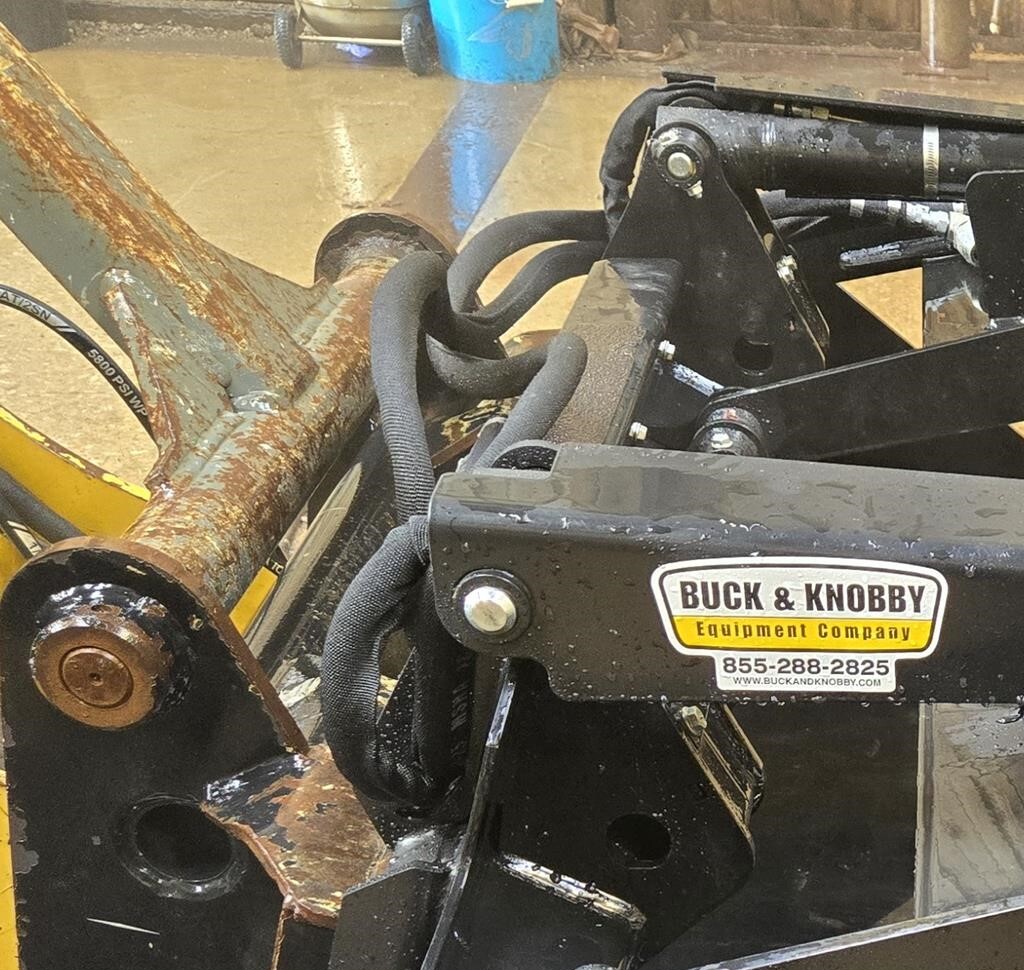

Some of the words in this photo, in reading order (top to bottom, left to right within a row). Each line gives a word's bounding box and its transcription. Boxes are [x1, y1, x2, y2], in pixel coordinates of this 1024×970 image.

[87, 348, 116, 377] 5800
[112, 374, 134, 397] PSI
[128, 395, 149, 417] WP
[679, 580, 764, 611] BUCK
[773, 586, 795, 611] &
[804, 582, 926, 613] KNOBBY
[696, 620, 807, 640] Equipment
[817, 622, 911, 641] Company
[722, 657, 890, 676] 855-288-2825
[733, 676, 881, 687] WWW.BUCKANDKNOBBY.COM
